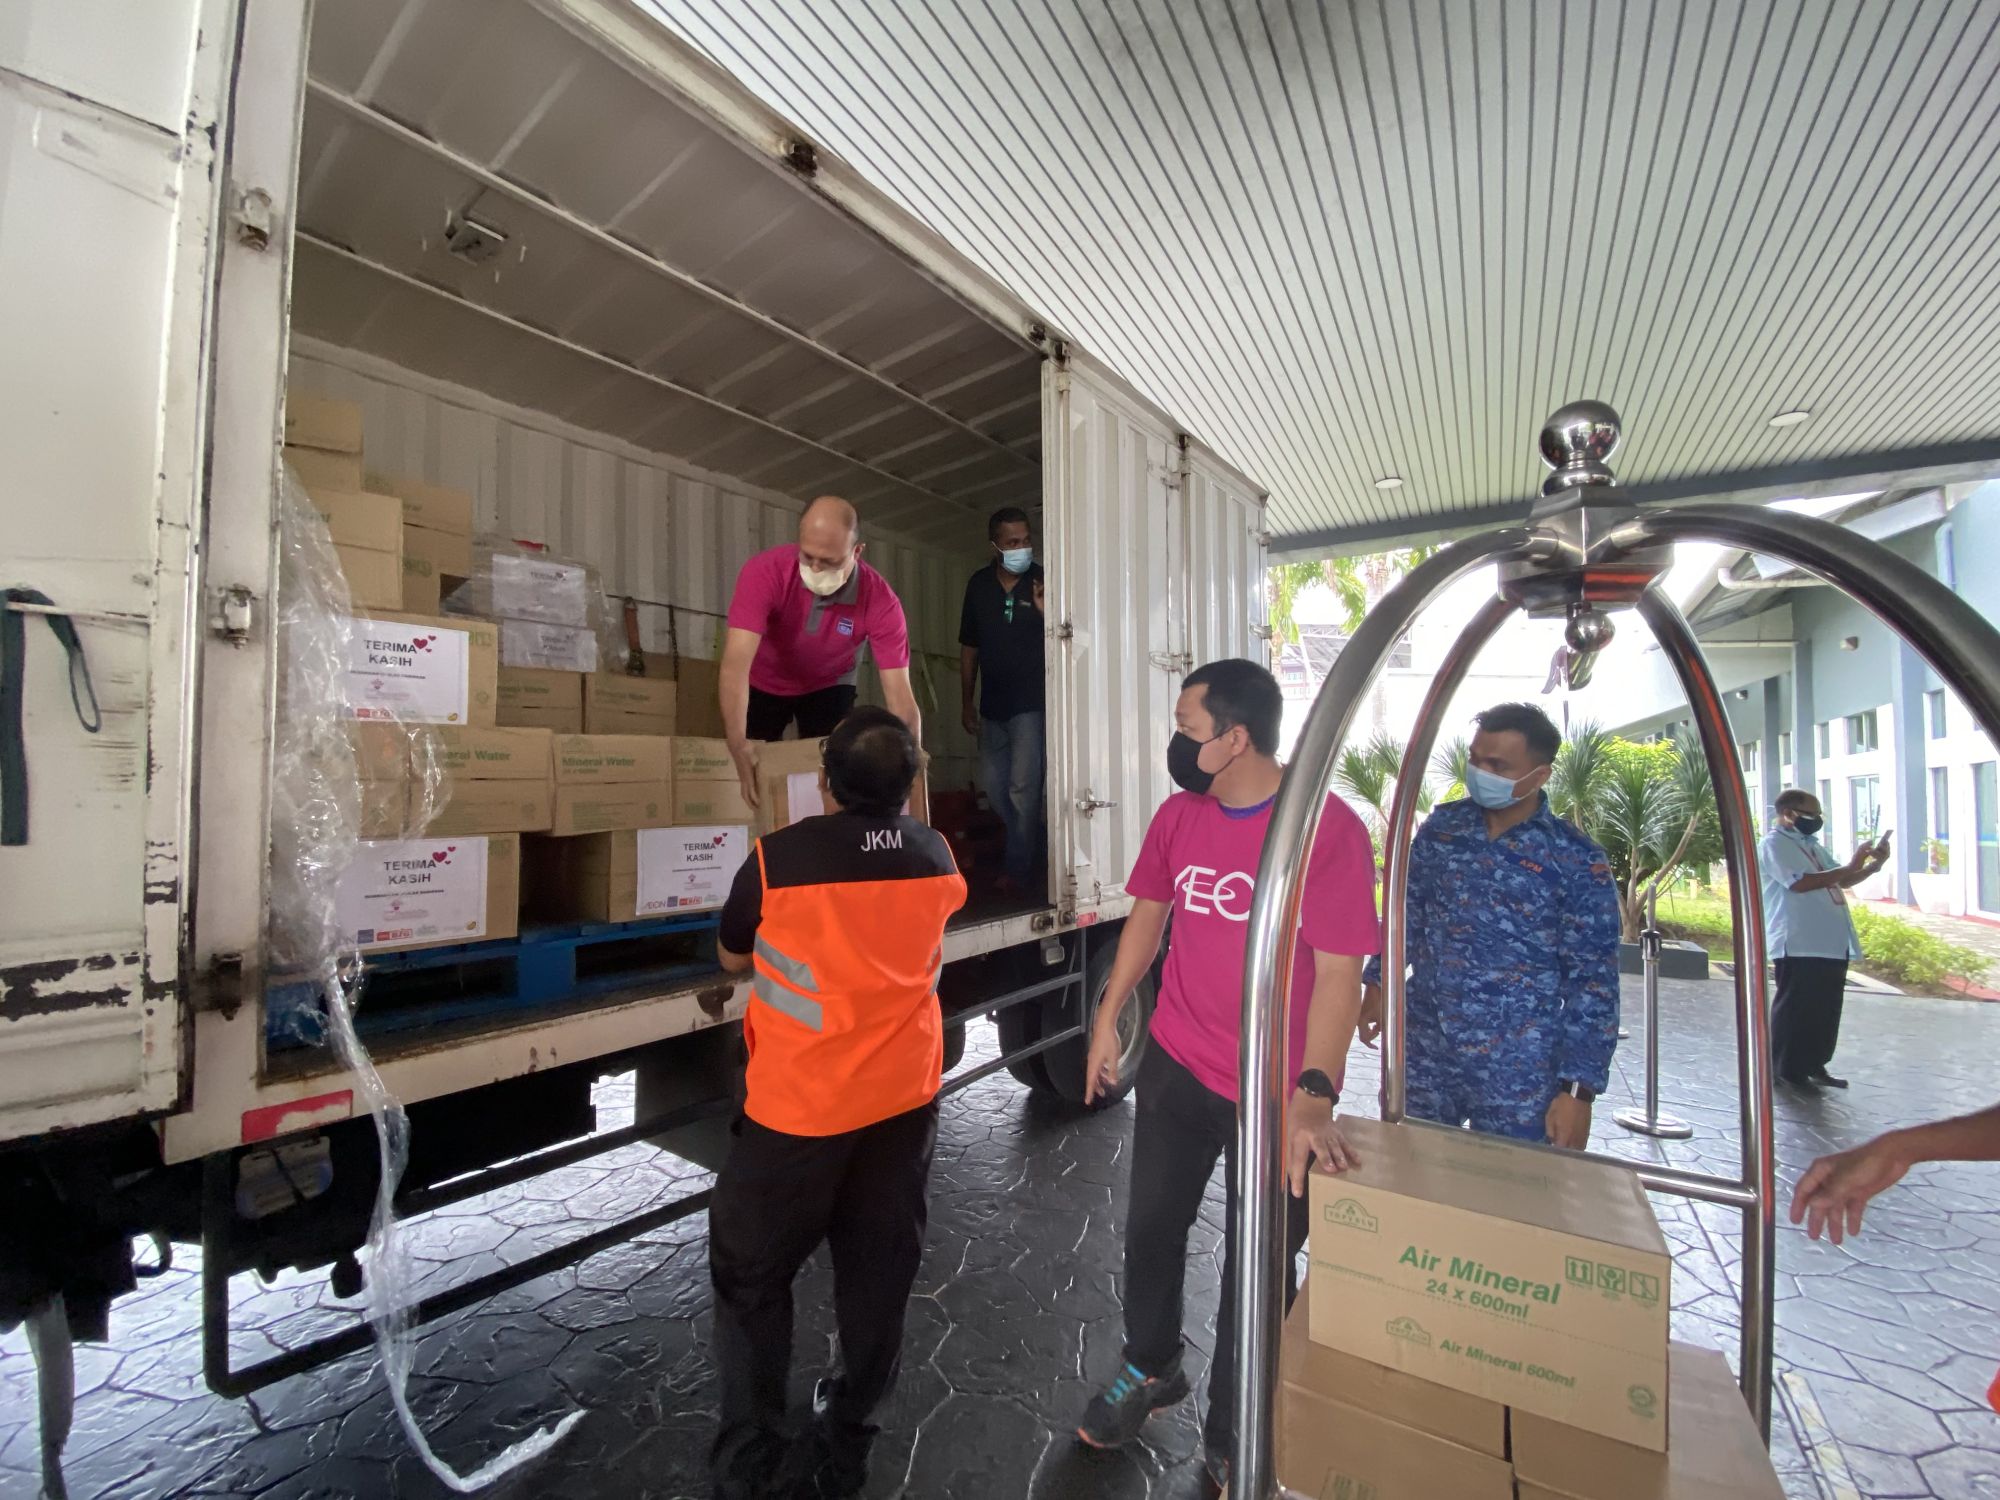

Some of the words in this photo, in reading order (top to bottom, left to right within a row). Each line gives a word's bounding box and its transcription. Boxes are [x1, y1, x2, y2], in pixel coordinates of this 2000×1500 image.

[364, 639, 418, 655] TERIMA
[368, 653, 412, 667] KASIH
[474, 750, 511, 761] Water
[561, 757, 602, 768] Mineral
[606, 757, 636, 767] Water
[678, 758, 693, 767] Air
[694, 757, 729, 767] Mineral
[683, 843, 717, 851] TERIMA
[860, 829, 903, 852] JKM
[686, 853, 713, 862] KASIH
[384, 859, 437, 871] TERIMA
[1519, 859, 1545, 874] APM
[388, 873, 431, 885] KASIH
[1328, 1210, 1375, 1229] TOPVALU
[1398, 1245, 1441, 1272] Air
[1448, 1257, 1561, 1304] Mineral
[1425, 1279, 1448, 1295] 24
[1453, 1287, 1465, 1301] x
[1469, 1290, 1530, 1318] 600ml
[1440, 1339, 1463, 1354] Air
[1465, 1345, 1523, 1373] Mineral
[1526, 1364, 1577, 1388] 600ml
